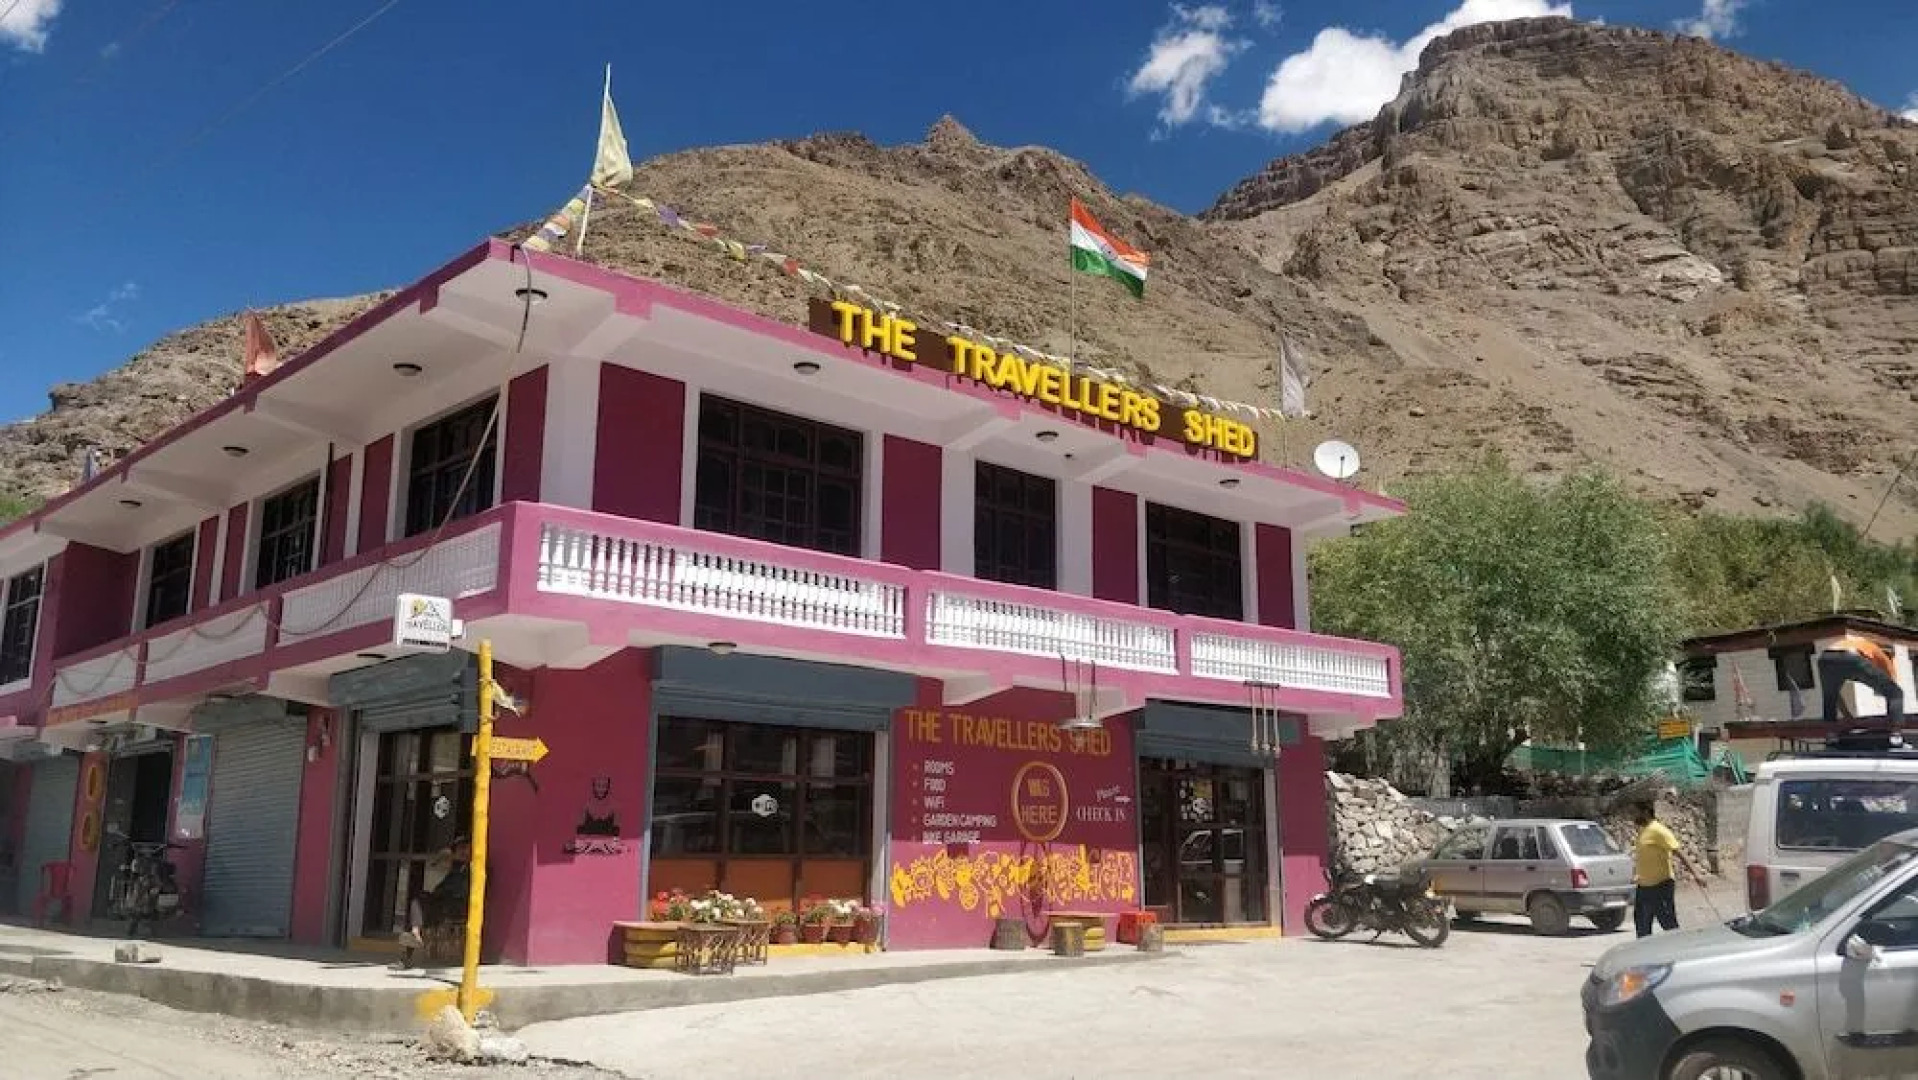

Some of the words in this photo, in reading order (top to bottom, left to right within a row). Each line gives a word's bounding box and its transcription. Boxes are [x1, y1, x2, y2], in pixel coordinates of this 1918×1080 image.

[831, 300, 916, 362] THE
[946, 335, 1162, 432] TRAVELLERS
[1184, 408, 1257, 459] SHED
[905, 710, 942, 743] THE
[950, 713, 1062, 753] TRAVELLERS
[1069, 729, 1112, 756] SHED
[923, 760, 954, 775] ROOMS
[923, 778, 946, 791] FOOD
[960, 814, 997, 828] CAMPING
[1021, 805, 1058, 824] HERE
[1076, 806, 1112, 821] CHECK
